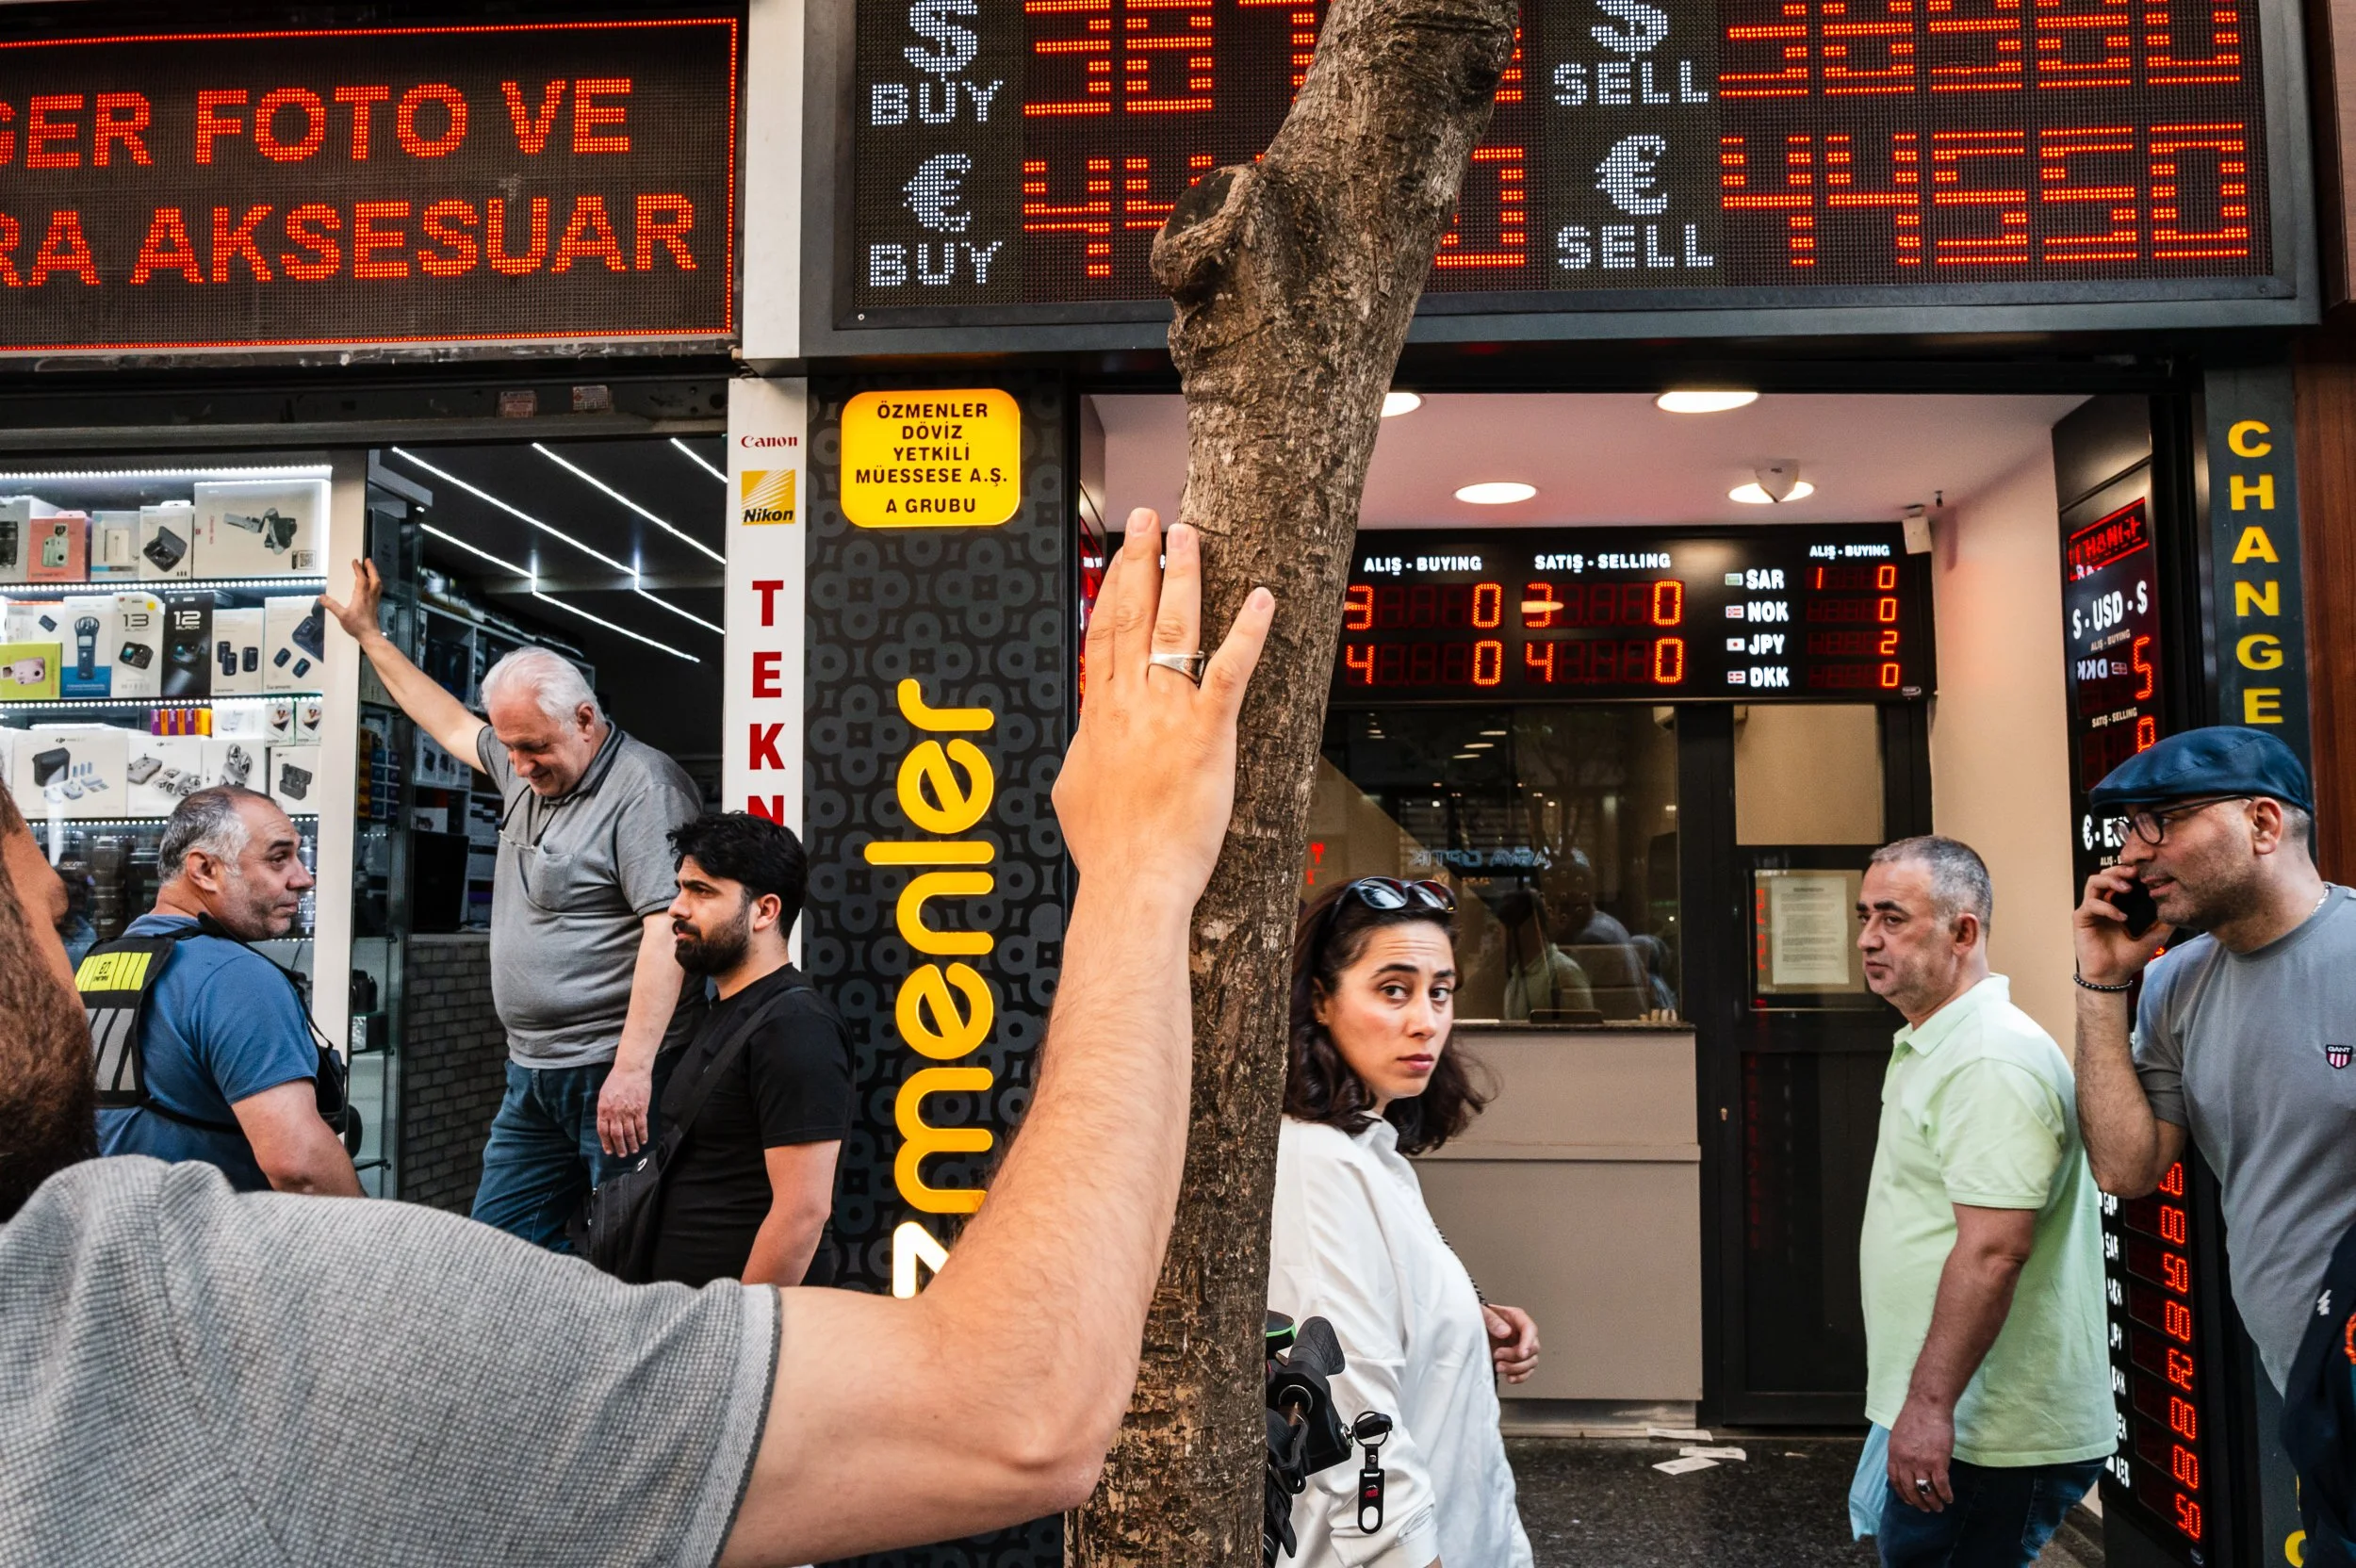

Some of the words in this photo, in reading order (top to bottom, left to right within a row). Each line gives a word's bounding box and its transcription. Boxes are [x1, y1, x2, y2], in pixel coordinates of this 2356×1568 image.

[1553, 60, 1709, 106] SELL
[871, 81, 1003, 125] BUY
[0, 91, 153, 169] ER
[194, 82, 468, 164] FOTO
[500, 78, 631, 155] VE
[1595, 135, 1668, 215] €
[902, 154, 972, 232] €
[1721, 122, 2249, 267] 44550
[130, 193, 697, 285] AKSESUAR
[1557, 223, 1715, 270] SELL
[869, 241, 1003, 286] BUY
[877, 400, 988, 419] ÖZMENLER
[741, 434, 798, 448] Canon
[902, 421, 962, 440] DÖVİZ
[893, 442, 970, 462] YETKİLİ
[856, 465, 961, 483] MÜESSESE
[970, 467, 1007, 486] A.Ş.
[743, 508, 794, 522] Nikon
[886, 498, 897, 513] A
[905, 498, 975, 513] GRUBU
[1597, 553, 1671, 569] SELLING
[1844, 545, 1890, 557] BUYING
[1416, 556, 1482, 571] BUYING
[2227, 419, 2285, 725] CHANGE
[1745, 569, 1784, 590] SAR
[123, 613, 149, 628] 13
[173, 611, 201, 626] 12
[1747, 601, 1790, 622] NOK
[2093, 591, 2123, 631] USD
[1748, 634, 1785, 655] JPY
[1750, 667, 1790, 687] DKK
